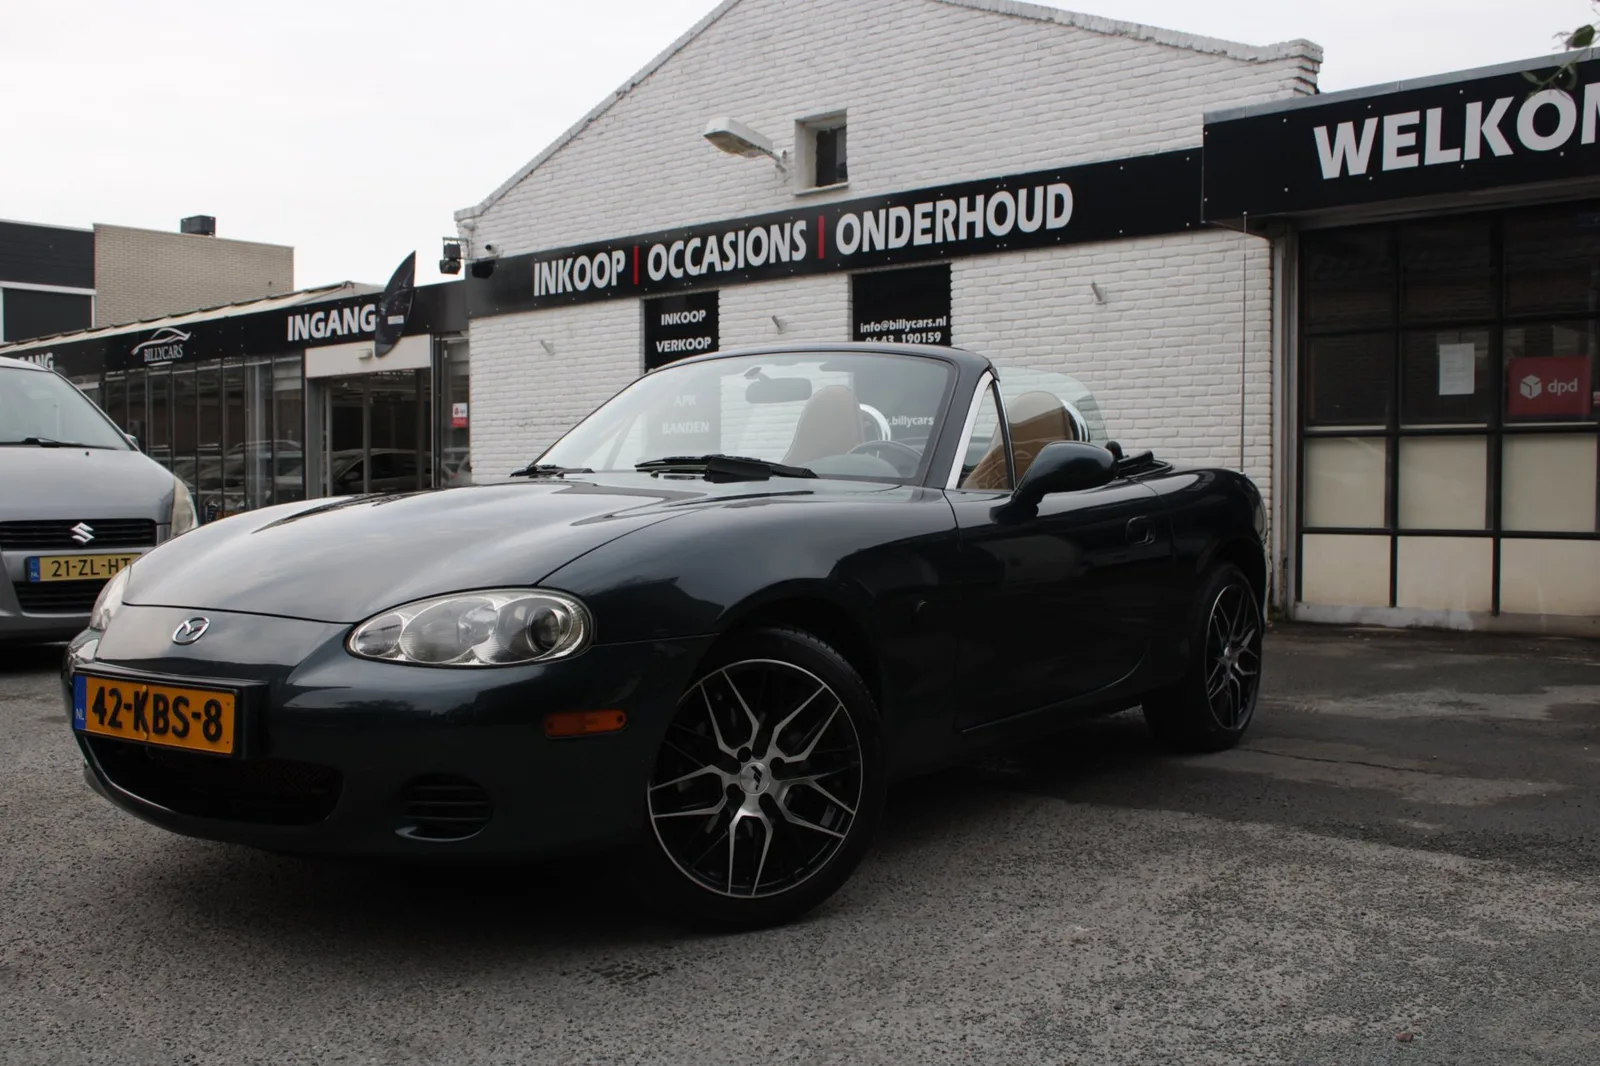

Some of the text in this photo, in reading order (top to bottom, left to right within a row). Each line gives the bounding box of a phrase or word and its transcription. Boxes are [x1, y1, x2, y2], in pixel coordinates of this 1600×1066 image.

[533, 183, 1074, 297] INKOOP OCCASIONS ONDERHOUD
[287, 303, 376, 342] INGANG
[660, 309, 707, 326] INKOOP
[860, 315, 947, 333] info@billycars.nl
[655, 336, 712, 353] VERKOOP
[901, 331, 942, 344] 190159
[143, 344, 184, 362] BILLYCARS
[1547, 378, 1578, 396] dpd
[661, 420, 710, 435] BANDEN
[886, 415, 935, 429] .billycars
[75, 708, 85, 721] NL
[91, 685, 222, 743] 42-KBS-8
